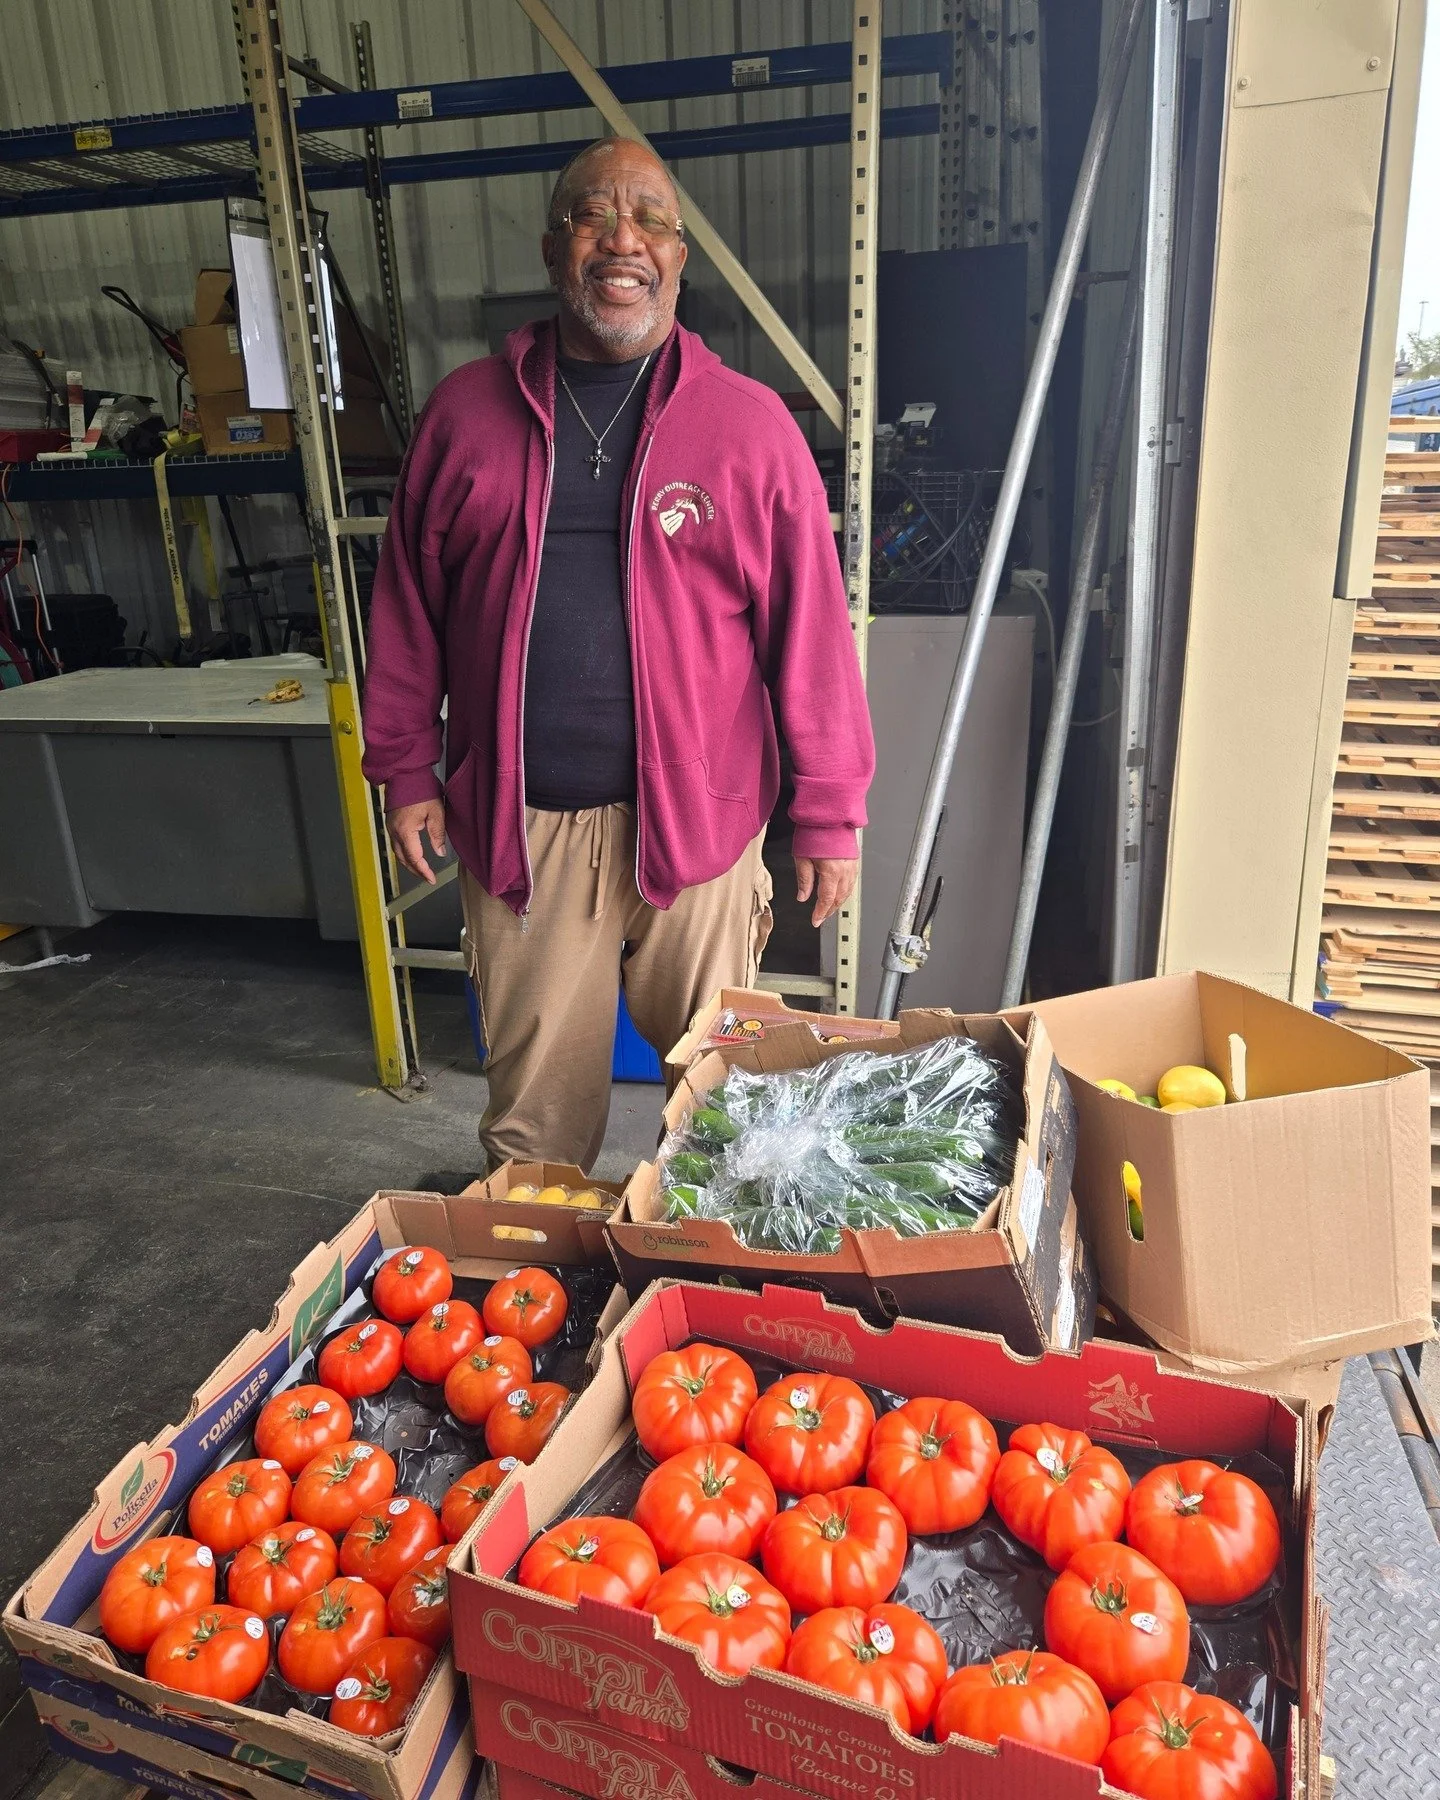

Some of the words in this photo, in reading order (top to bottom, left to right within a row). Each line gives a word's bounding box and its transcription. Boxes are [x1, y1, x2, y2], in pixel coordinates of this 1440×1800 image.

[658, 1234, 710, 1249] robinson
[743, 1313, 855, 1354] COPPOLA
[803, 1336, 855, 1364] farms
[198, 1367, 269, 1451] TOMATES
[112, 1478, 159, 1532] Policella
[482, 1608, 690, 1711] COPPOLA
[584, 1671, 690, 1731] farms
[744, 1697, 833, 1737] Greenhouse
[837, 1729, 893, 1758] Grown
[501, 1700, 697, 1800] COPPOLA
[745, 1713, 915, 1788] TOMATOES
